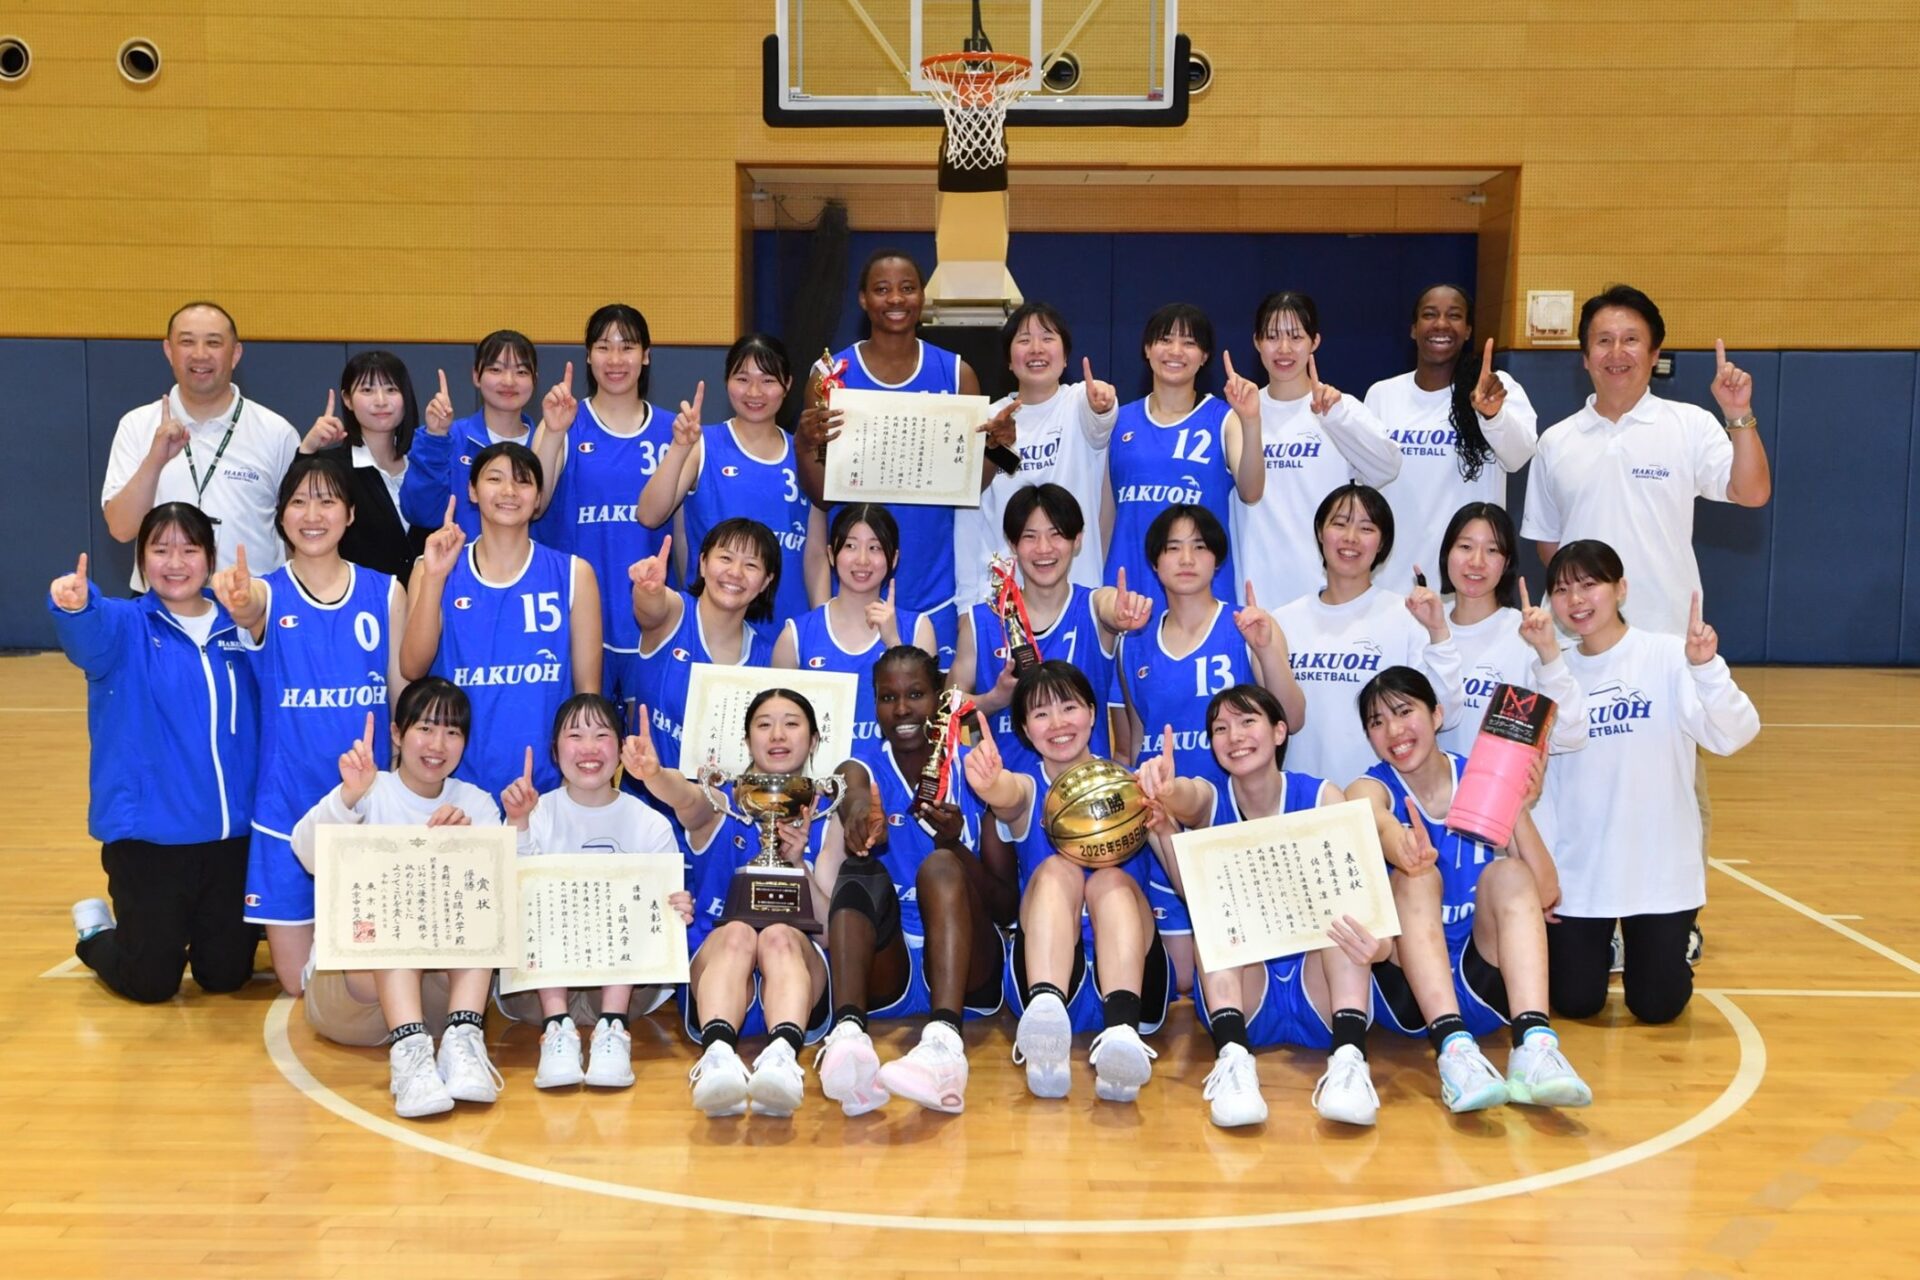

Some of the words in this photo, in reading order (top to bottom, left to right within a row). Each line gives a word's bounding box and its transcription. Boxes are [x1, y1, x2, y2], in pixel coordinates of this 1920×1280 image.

[1171, 428, 1212, 465] 12
[1263, 443, 1321, 458] KUOH
[520, 591, 562, 633] 15
[354, 611, 380, 652] 0
[454, 663, 562, 687] HAKUOH
[1195, 654, 1235, 697] 13
[1293, 671, 1361, 683] ASKETBALL
[280, 685, 388, 708] HAKUOH
[1089, 792, 1126, 822] 優勝
[1344, 851, 1363, 891] 表彰状
[476, 877, 492, 911] 賞状
[649, 899, 662, 934] 表彰状
